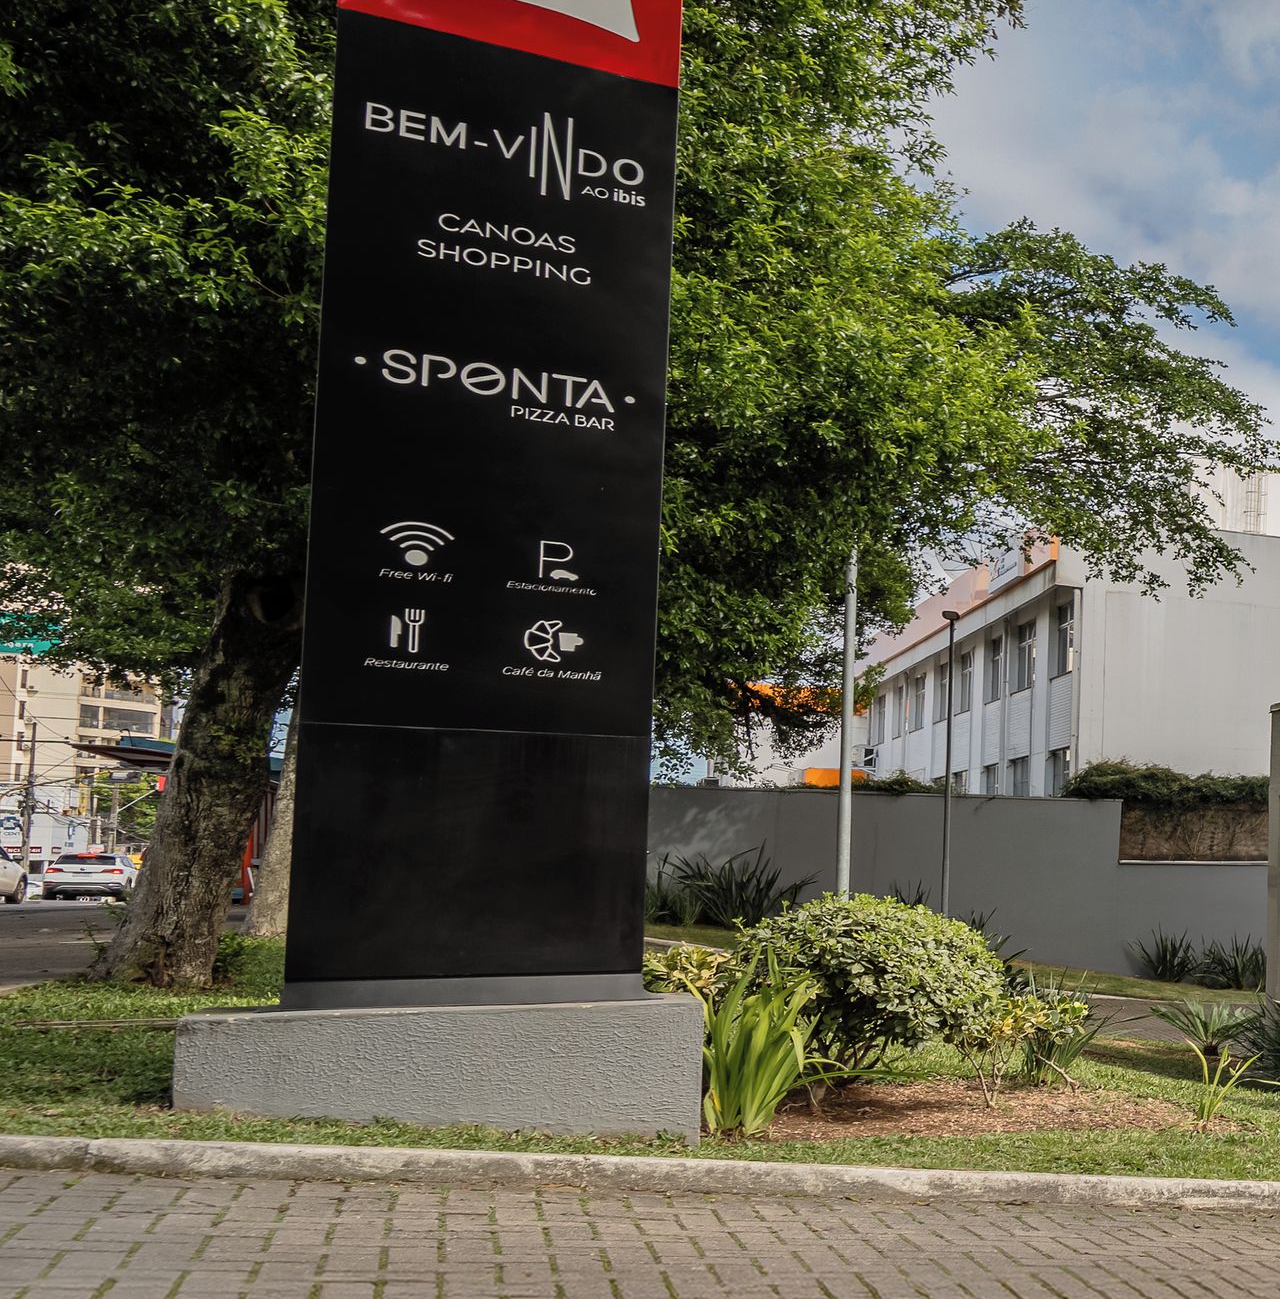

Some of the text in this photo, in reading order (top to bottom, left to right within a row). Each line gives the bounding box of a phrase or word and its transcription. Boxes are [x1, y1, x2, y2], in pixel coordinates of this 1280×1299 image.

[364, 101, 645, 200] BEM-VINDO
[581, 186, 646, 207] AO ibis
[438, 213, 576, 254] CANOAS
[417, 239, 592, 286] SHOPPING
[511, 405, 615, 431] PIZZA BAR
[378, 568, 454, 583] Free Wi-fi
[506, 580, 598, 596] Estacionamento
[363, 657, 450, 671] Restaurante
[502, 666, 602, 681] Café da Manhã
